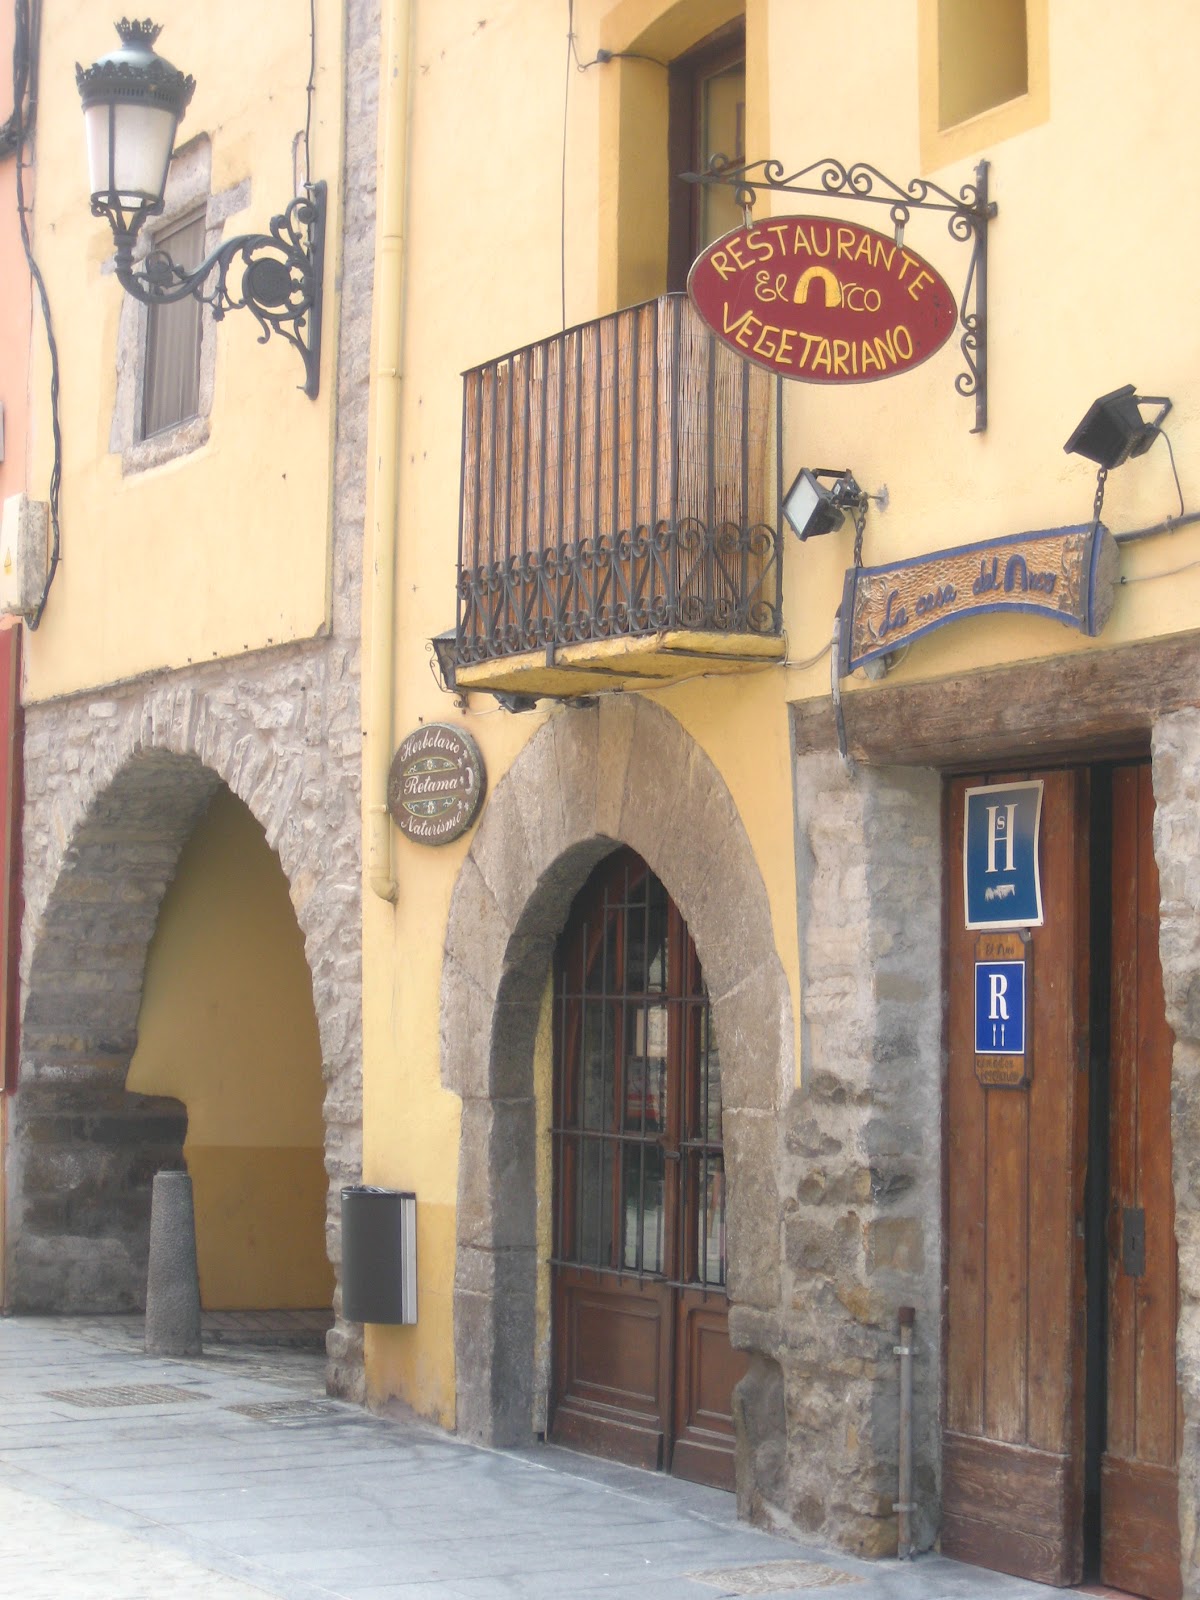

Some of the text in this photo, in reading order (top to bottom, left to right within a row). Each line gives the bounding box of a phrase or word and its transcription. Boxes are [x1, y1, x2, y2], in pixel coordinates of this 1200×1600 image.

[710, 224, 935, 302] RESTAURANTE
[754, 269, 789, 303] El
[722, 301, 913, 375] VEGETARIANO
[878, 588, 909, 638] La
[915, 583, 957, 615] casa
[972, 555, 1002, 596] del
[400, 729, 460, 762] Herbolario
[403, 775, 459, 795] Retama
[400, 810, 462, 836] Naturismo
[988, 973, 1010, 1020] R
